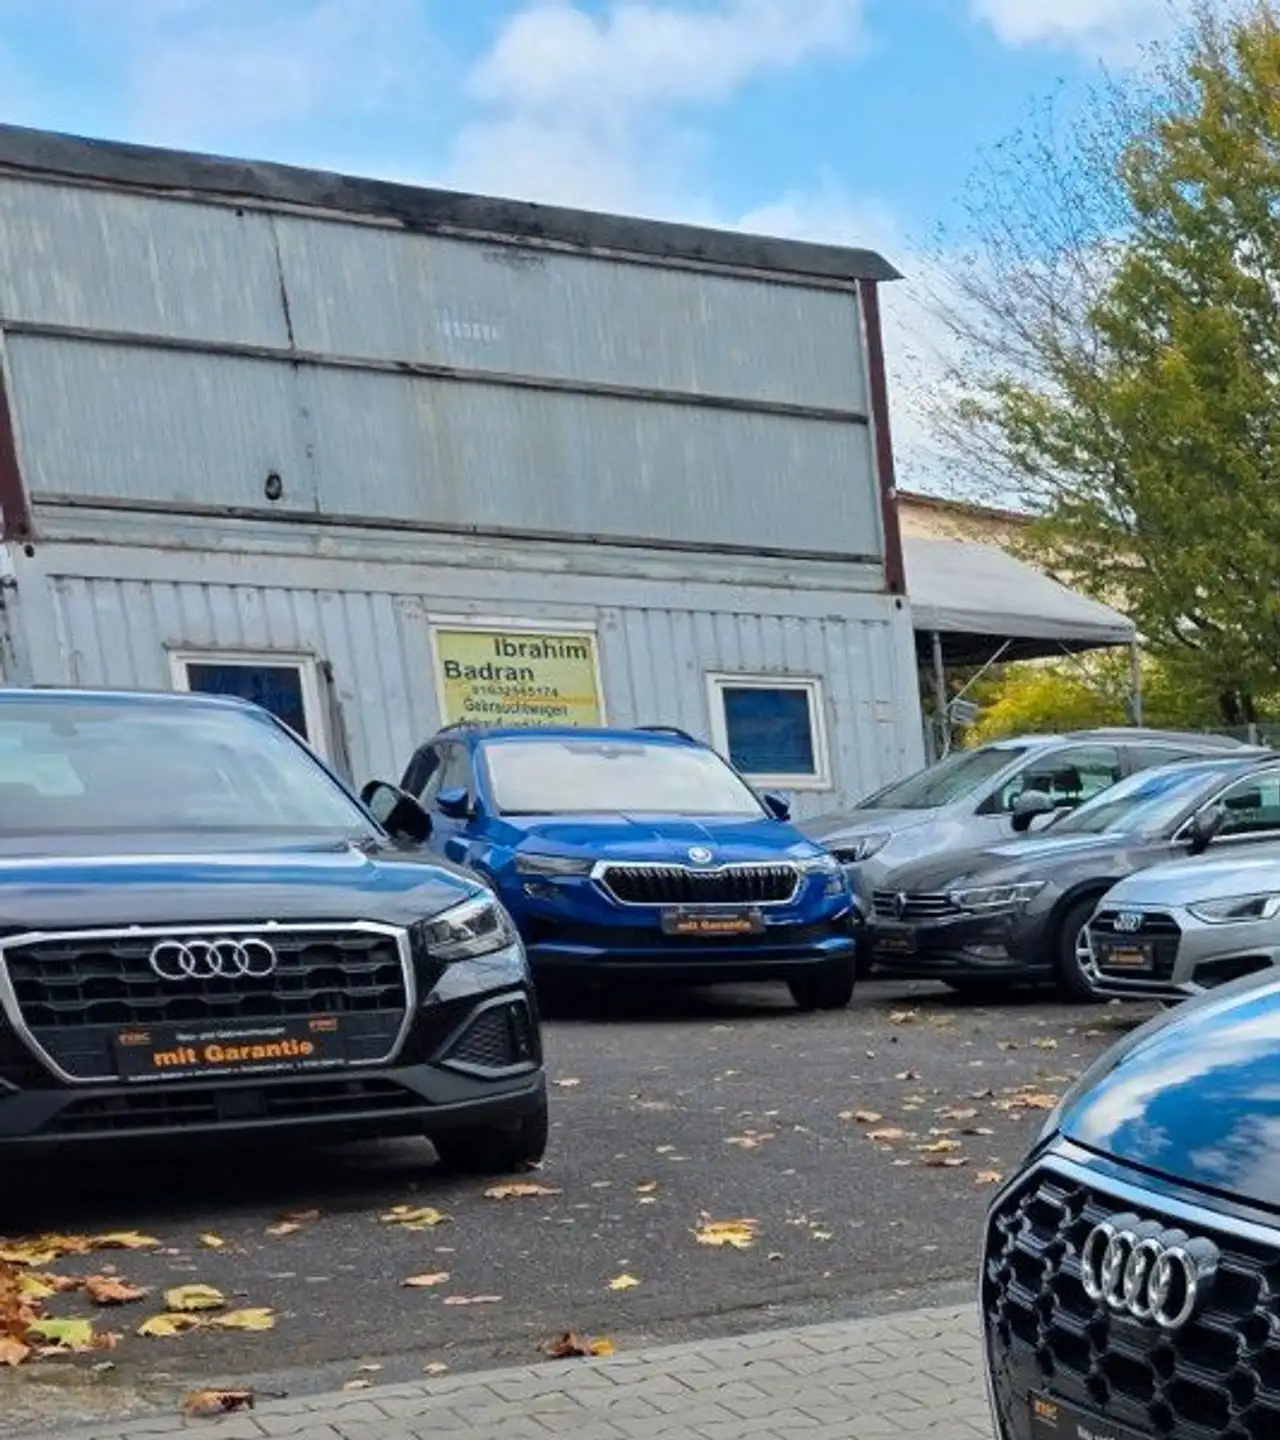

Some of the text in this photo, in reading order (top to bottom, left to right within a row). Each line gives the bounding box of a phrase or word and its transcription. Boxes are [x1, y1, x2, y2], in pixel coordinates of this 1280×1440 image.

[494, 637, 588, 660] Ibrahim
[444, 659, 535, 681] Badran
[153, 1039, 315, 1068] mit Garantie
